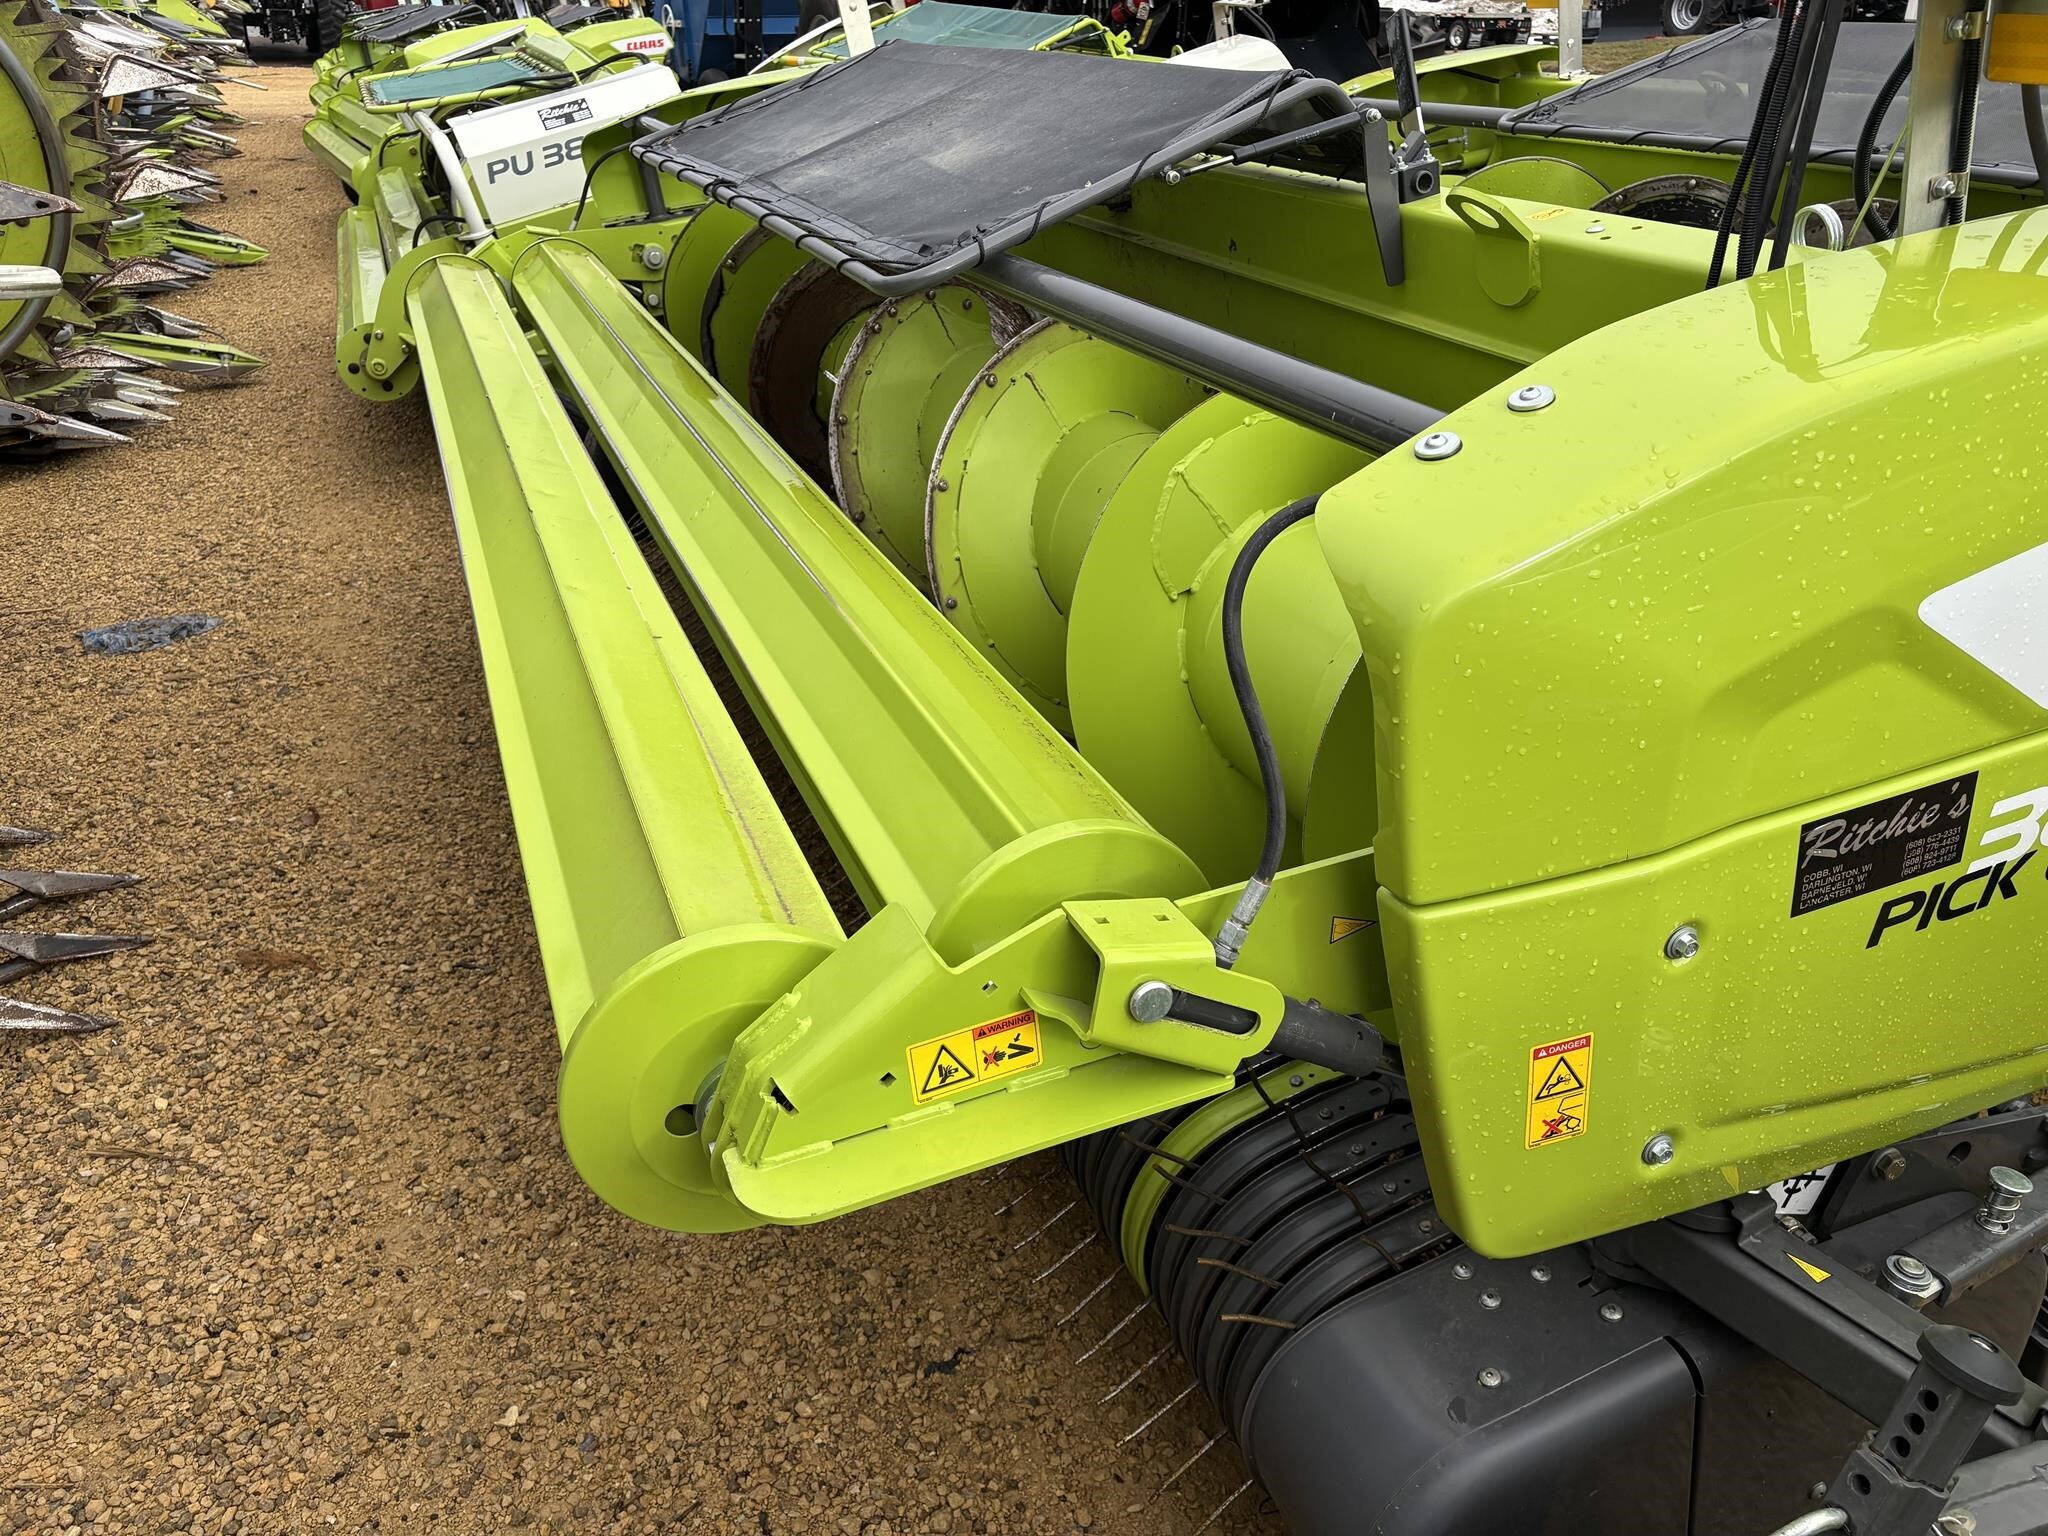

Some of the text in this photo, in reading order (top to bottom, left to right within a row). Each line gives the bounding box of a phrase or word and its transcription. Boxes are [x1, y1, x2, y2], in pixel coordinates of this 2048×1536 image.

[627, 39, 664, 51] CLAAS
[487, 151, 534, 185] PU
[1801, 782, 1970, 869] Ritchie's
[1969, 786, 2048, 875] 3
[1865, 849, 2038, 950] PICK
[986, 1013, 1031, 1034] WARNING
[1548, 1038, 1587, 1054] DANGER
